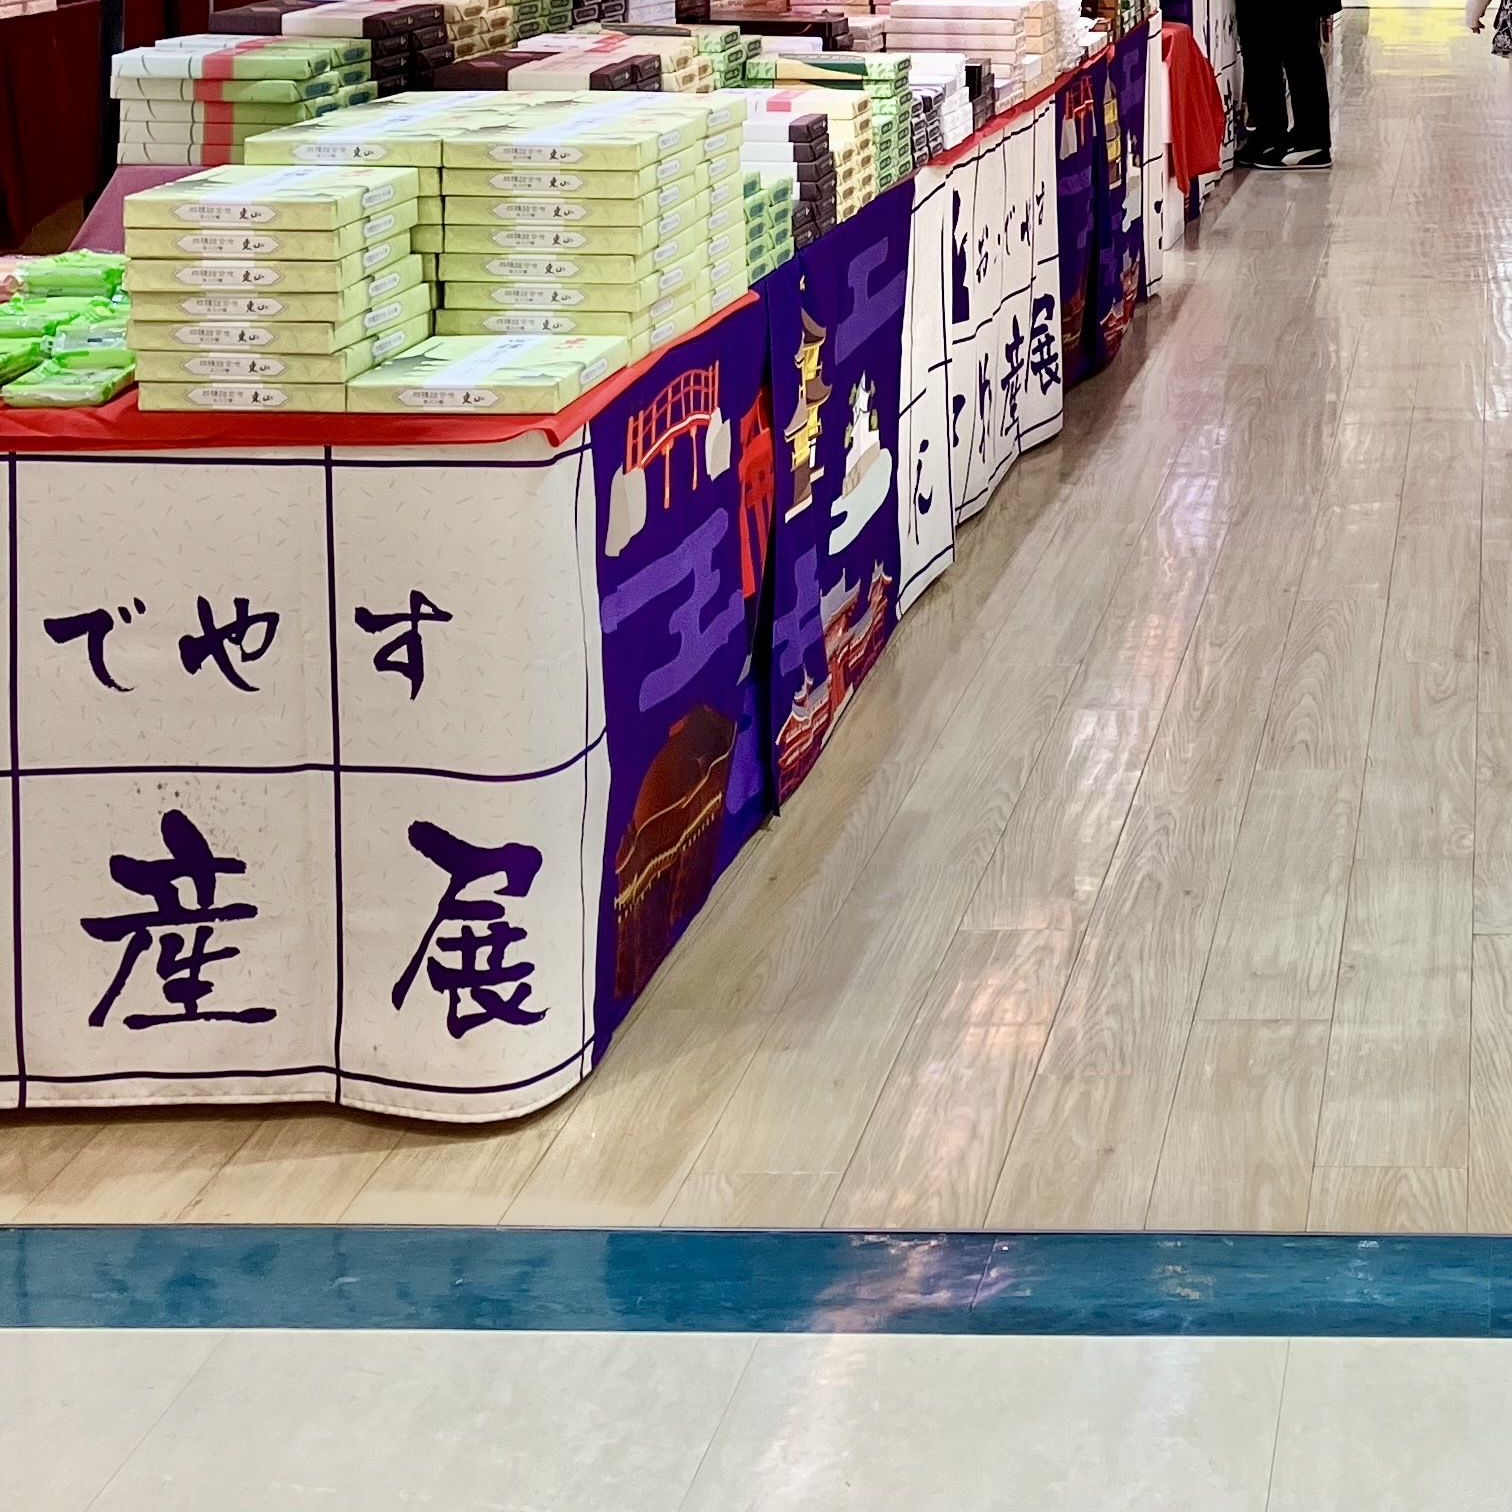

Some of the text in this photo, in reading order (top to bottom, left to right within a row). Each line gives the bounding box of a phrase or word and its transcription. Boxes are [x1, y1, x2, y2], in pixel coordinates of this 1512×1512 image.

[43, 590, 453, 700] でやす
[80, 808, 549, 1039] 産展
